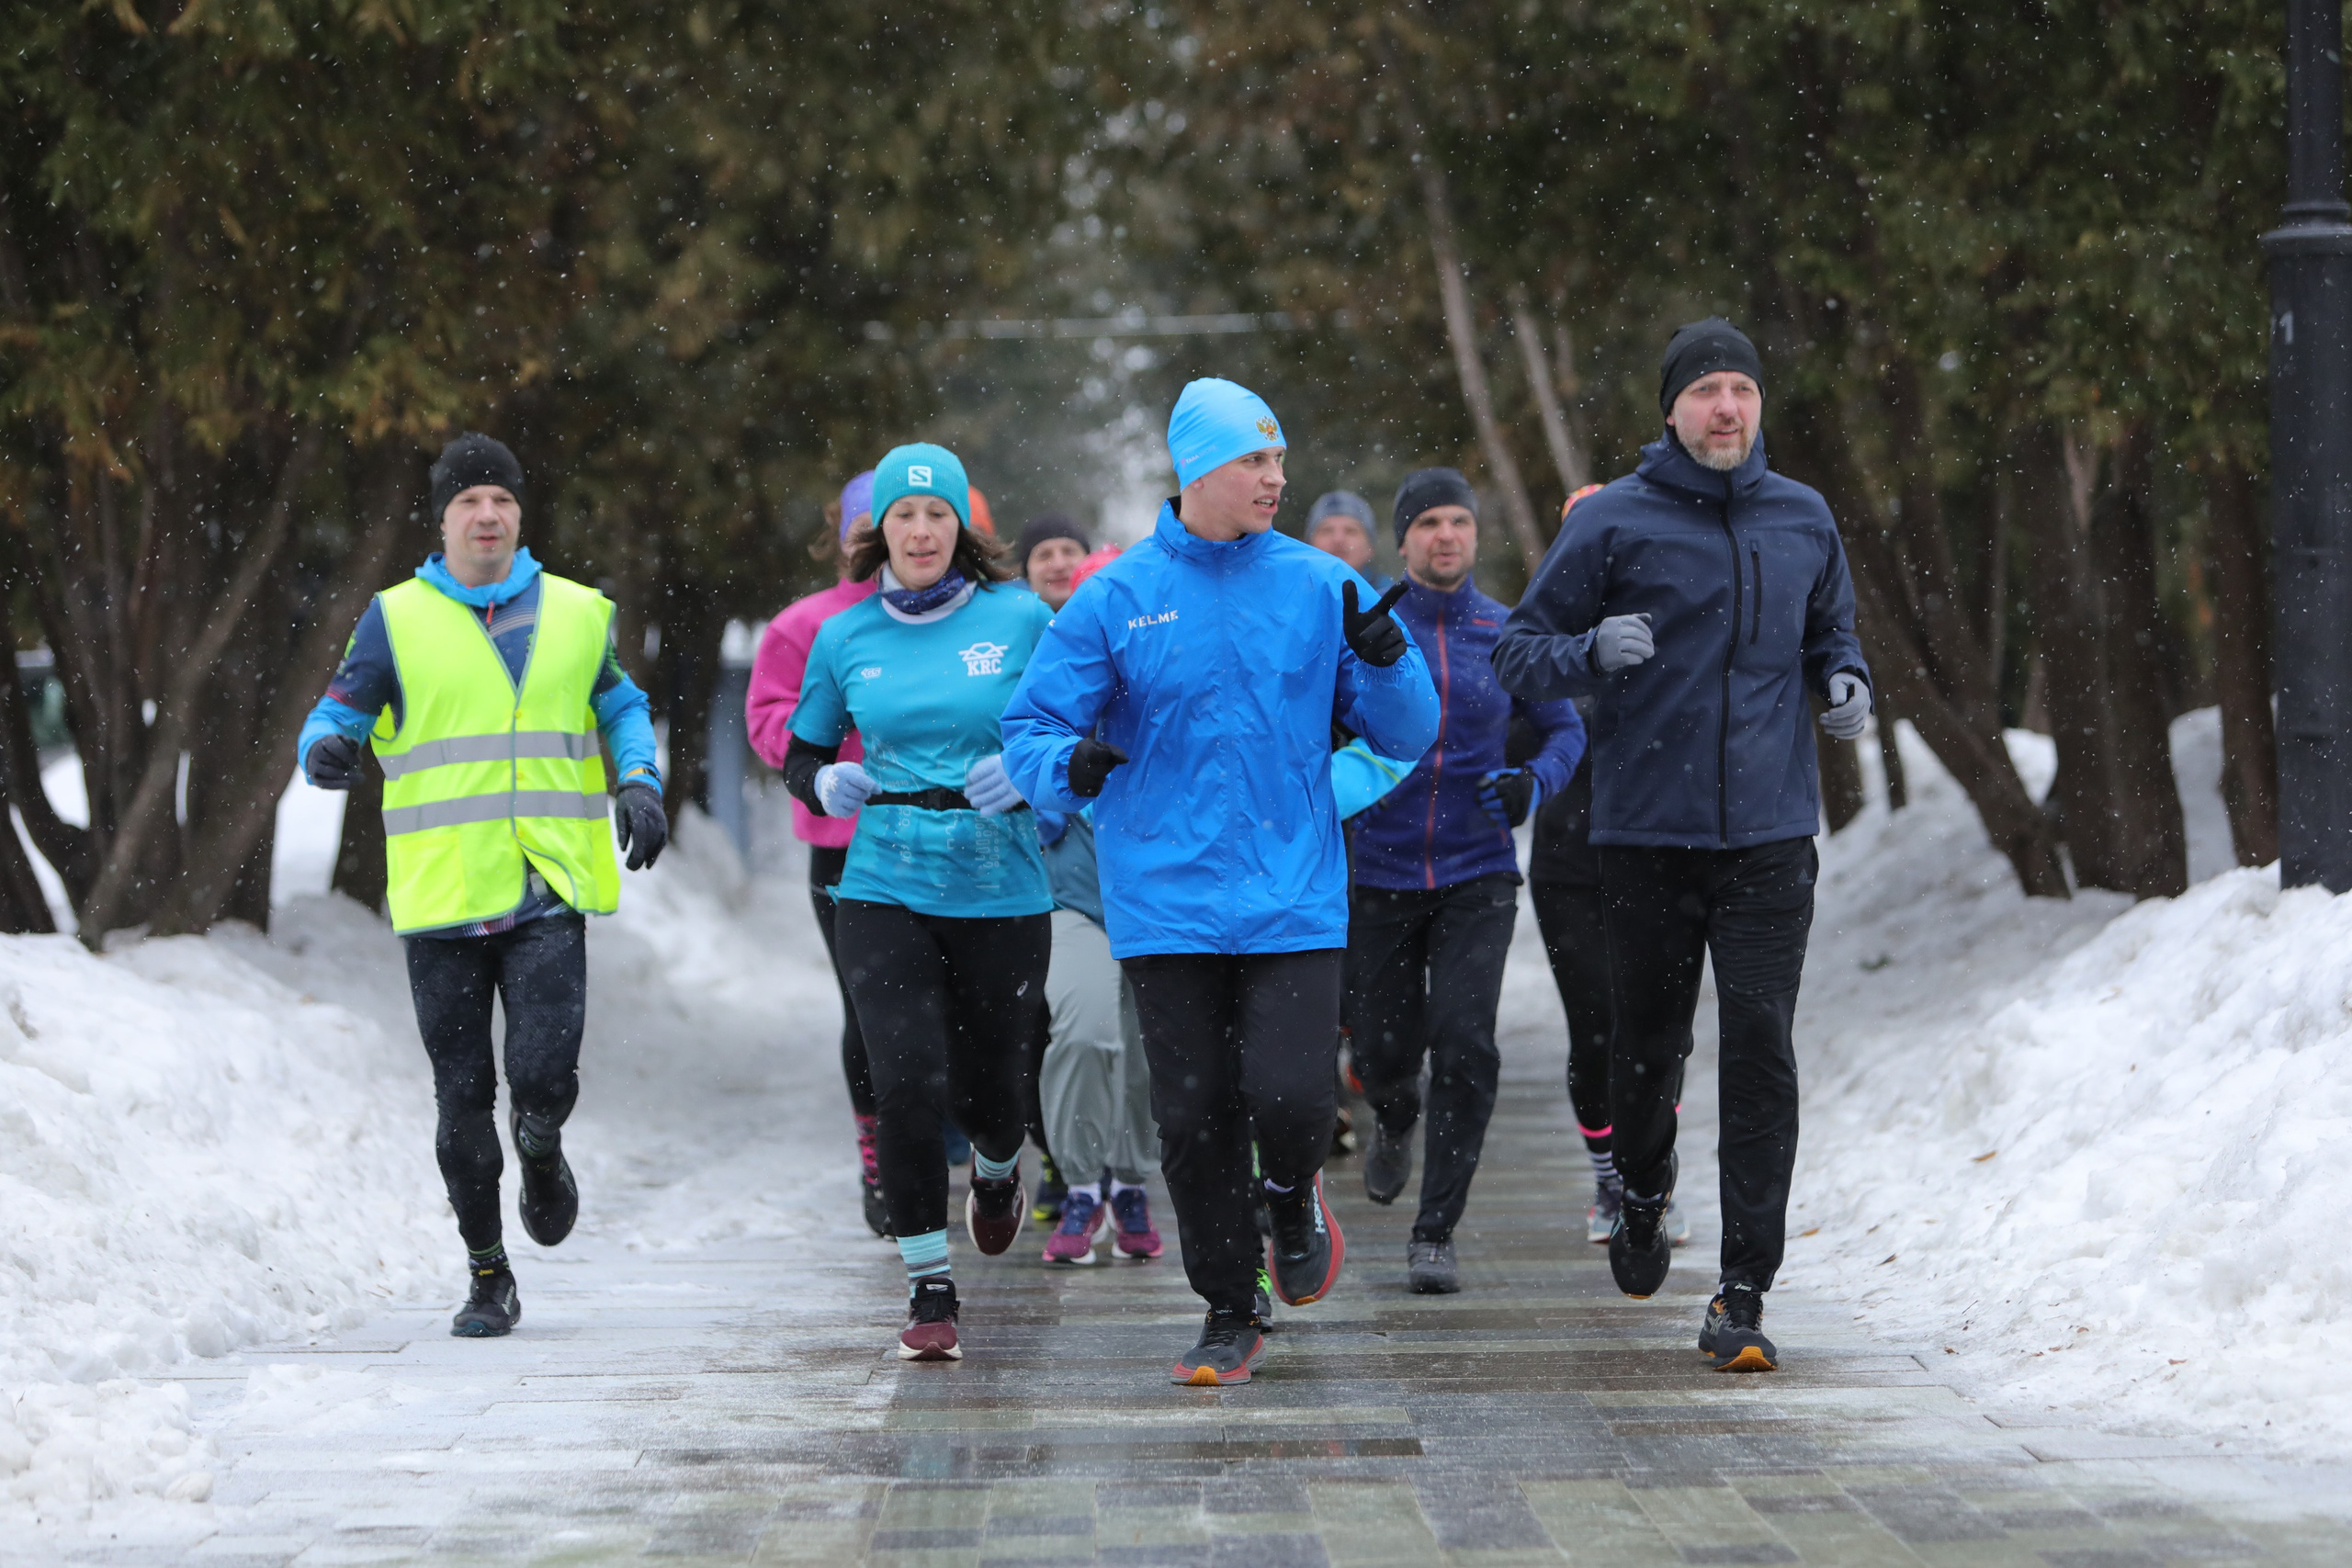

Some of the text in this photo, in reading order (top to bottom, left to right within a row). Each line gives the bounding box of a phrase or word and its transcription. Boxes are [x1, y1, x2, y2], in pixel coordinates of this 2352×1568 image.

[1127, 609, 1179, 630] KELME
[967, 658, 1001, 677] KRC
[1312, 1185, 1326, 1234] HOKA
